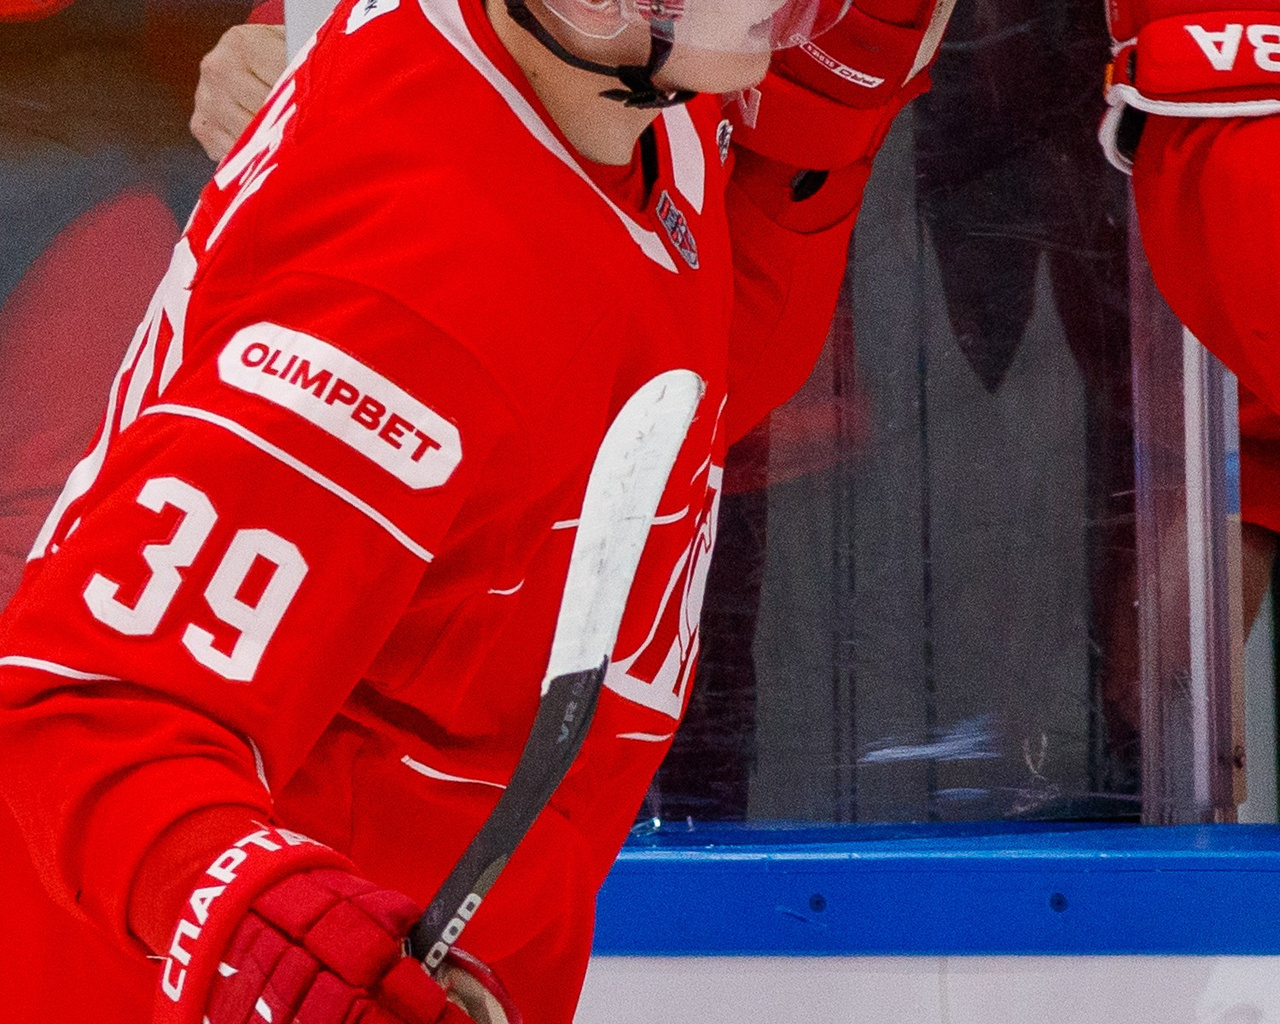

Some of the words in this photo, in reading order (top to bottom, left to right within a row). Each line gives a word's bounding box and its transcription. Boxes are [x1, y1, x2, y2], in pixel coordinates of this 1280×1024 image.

[239, 342, 442, 464] OLIMPBET
[82, 475, 310, 683] 39
[161, 826, 332, 1002] СПАРТА
